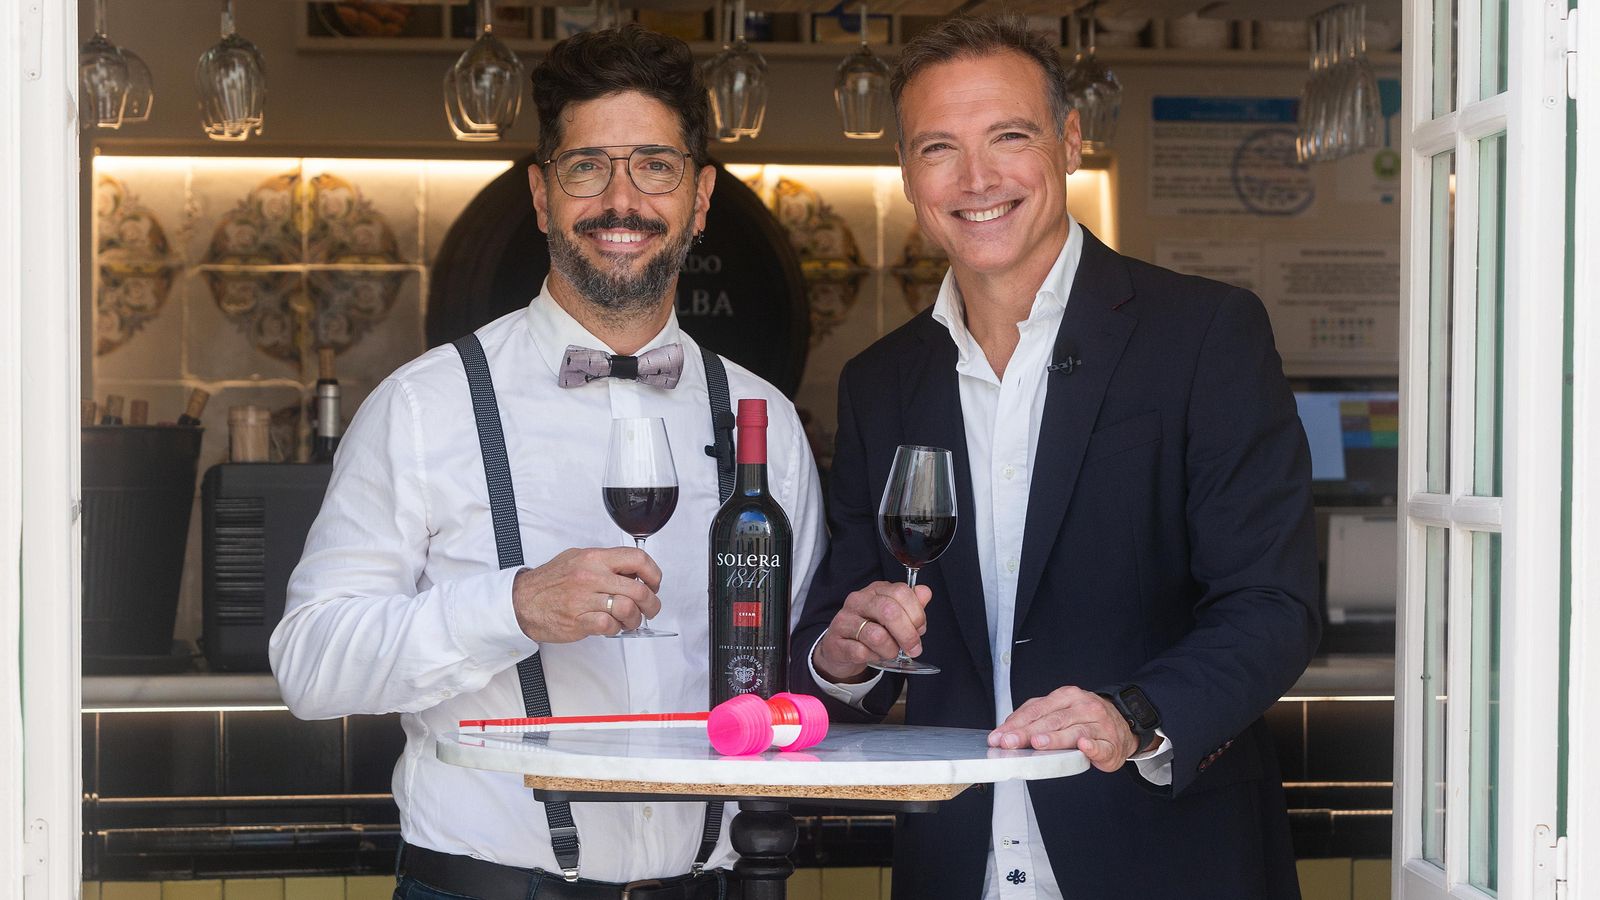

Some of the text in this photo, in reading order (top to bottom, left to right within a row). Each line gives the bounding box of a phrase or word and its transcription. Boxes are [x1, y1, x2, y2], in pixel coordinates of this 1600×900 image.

[680, 255, 723, 273] DO
[677, 288, 734, 316] LBA
[726, 567, 770, 589] 1847
